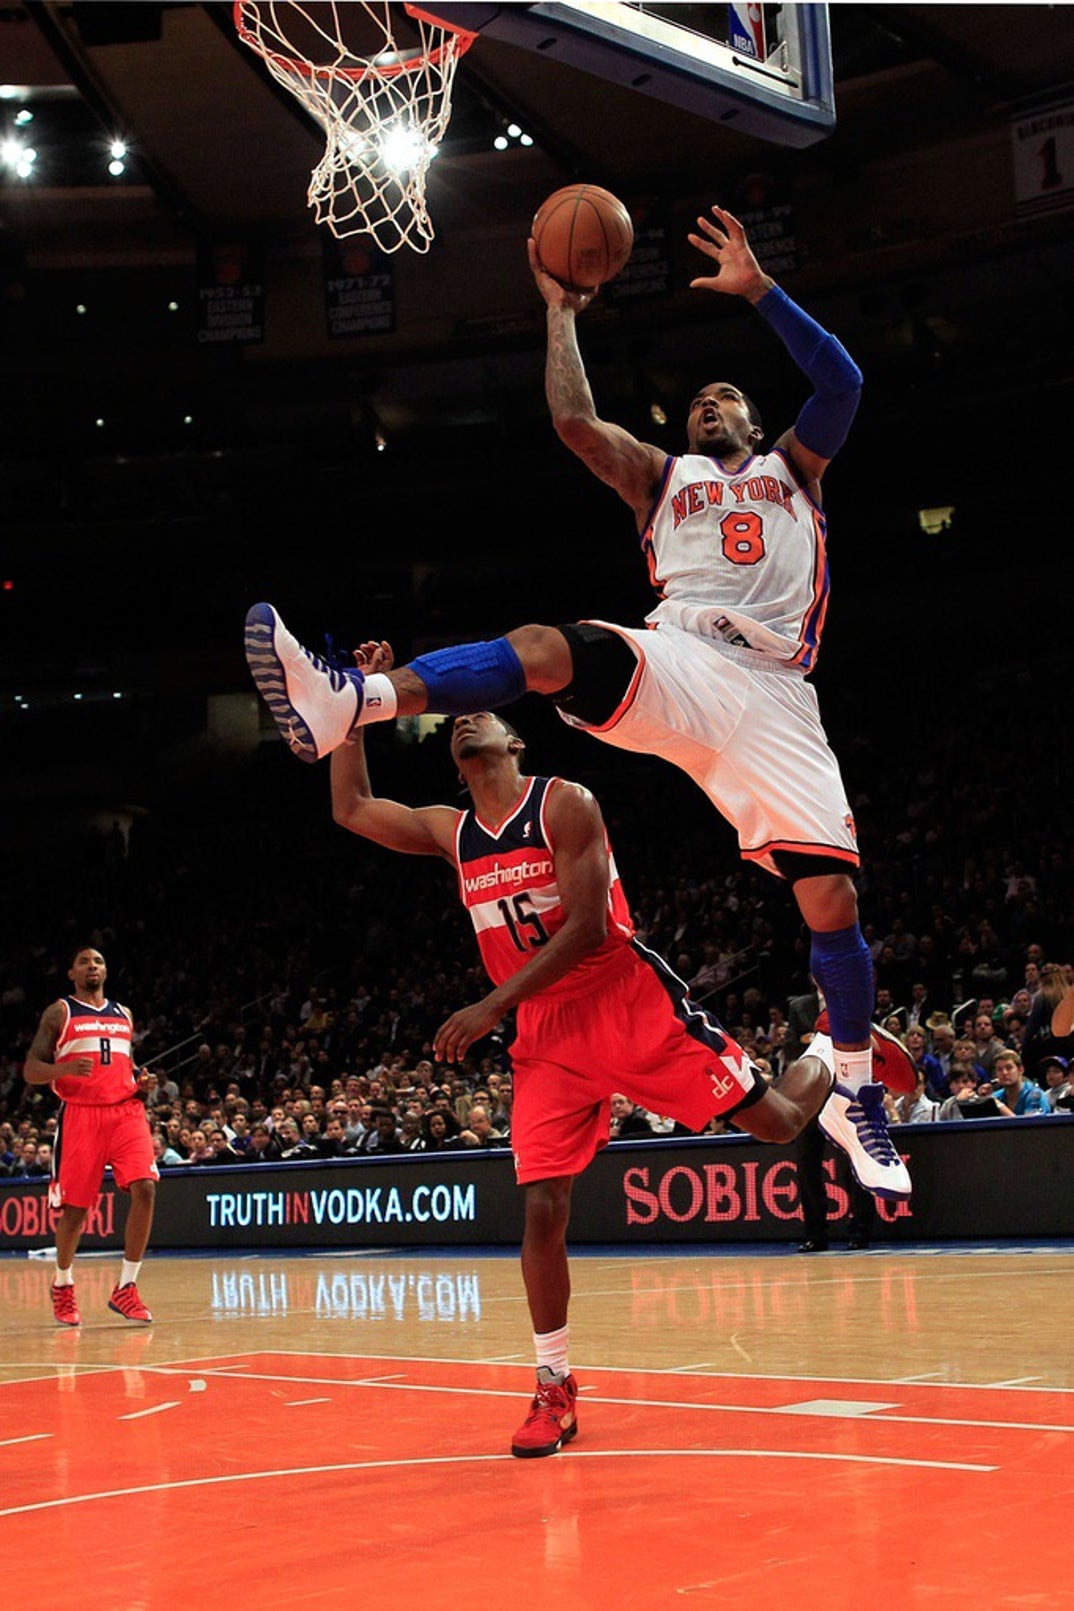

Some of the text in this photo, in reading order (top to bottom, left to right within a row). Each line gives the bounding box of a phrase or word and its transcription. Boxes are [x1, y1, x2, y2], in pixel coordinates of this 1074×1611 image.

[733, 33, 754, 54] NBA
[1038, 136, 1062, 190] 1
[671, 481, 724, 530] NEW
[719, 511, 766, 566] 8
[497, 891, 550, 952] 15
[99, 1037, 111, 1066] 8
[206, 1183, 476, 1227] TRUTHINVODKA.COM
[622, 1152, 912, 1226] SOBIES
